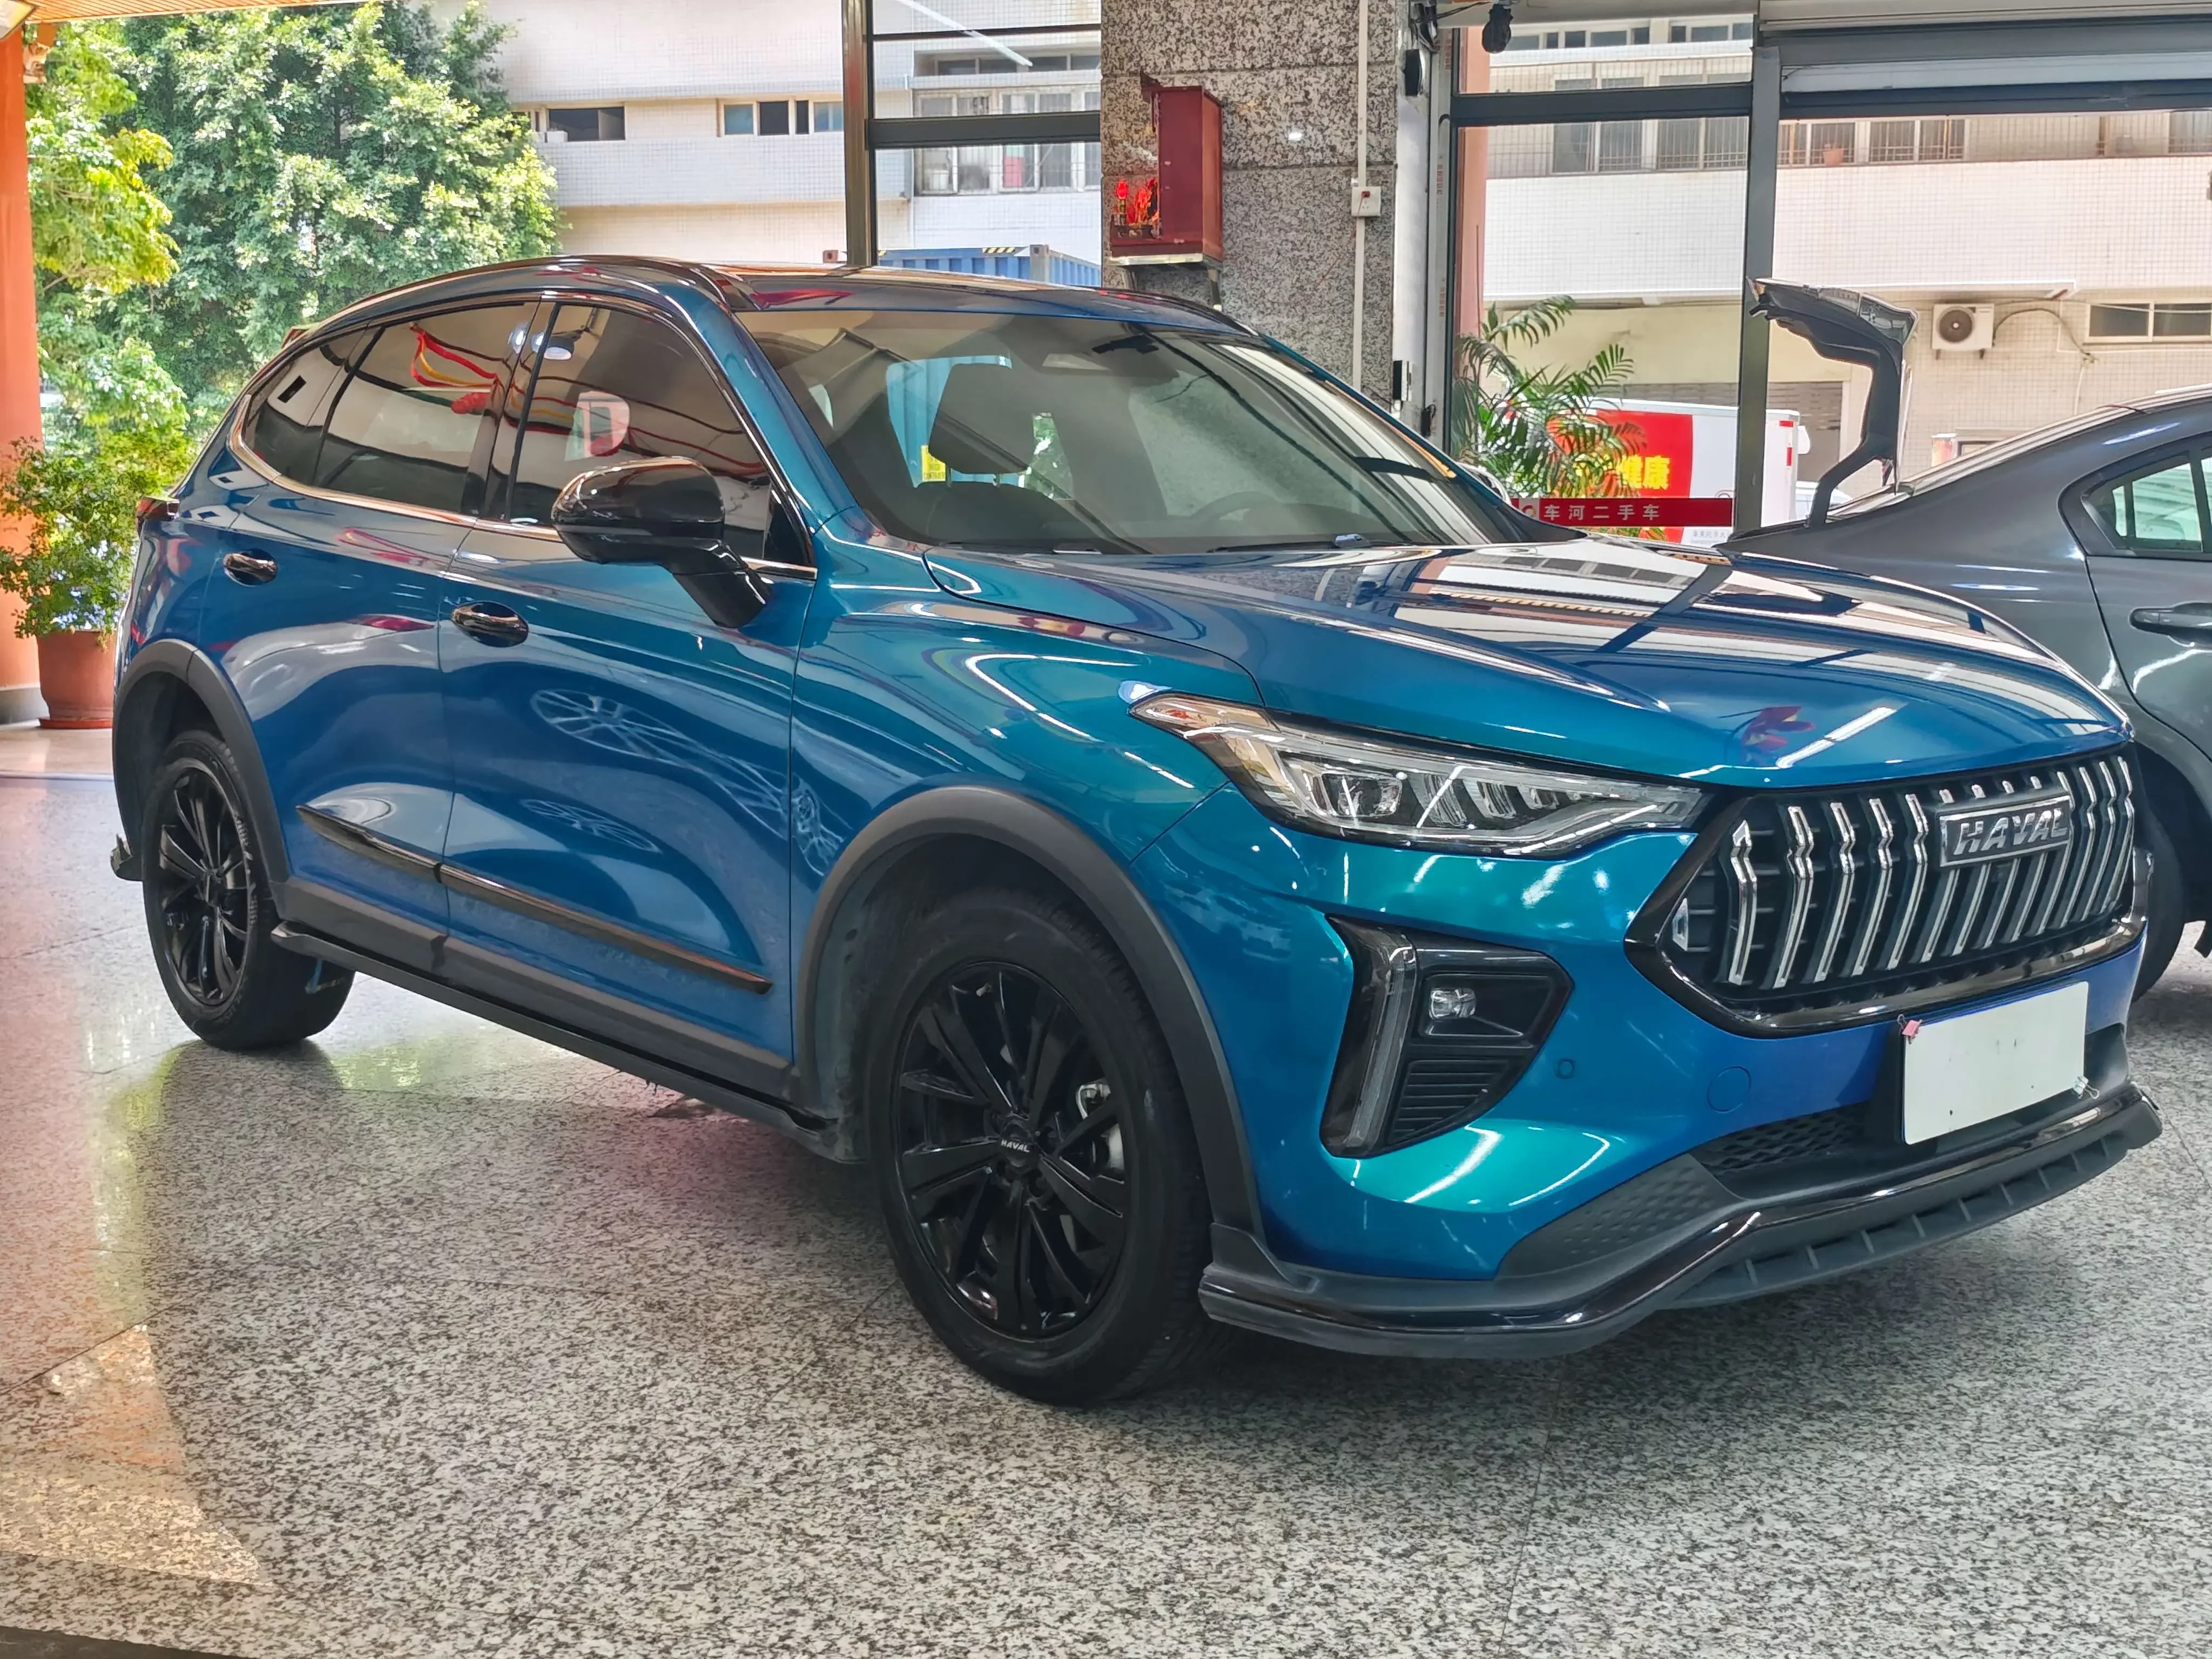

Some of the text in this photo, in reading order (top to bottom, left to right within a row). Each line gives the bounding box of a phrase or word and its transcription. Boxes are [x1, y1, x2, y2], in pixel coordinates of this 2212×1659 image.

[1543, 504, 1660, 521] 车河二手车
[1953, 808, 2069, 855] HAVAL
[1001, 1139, 1030, 1152] HAVAL
